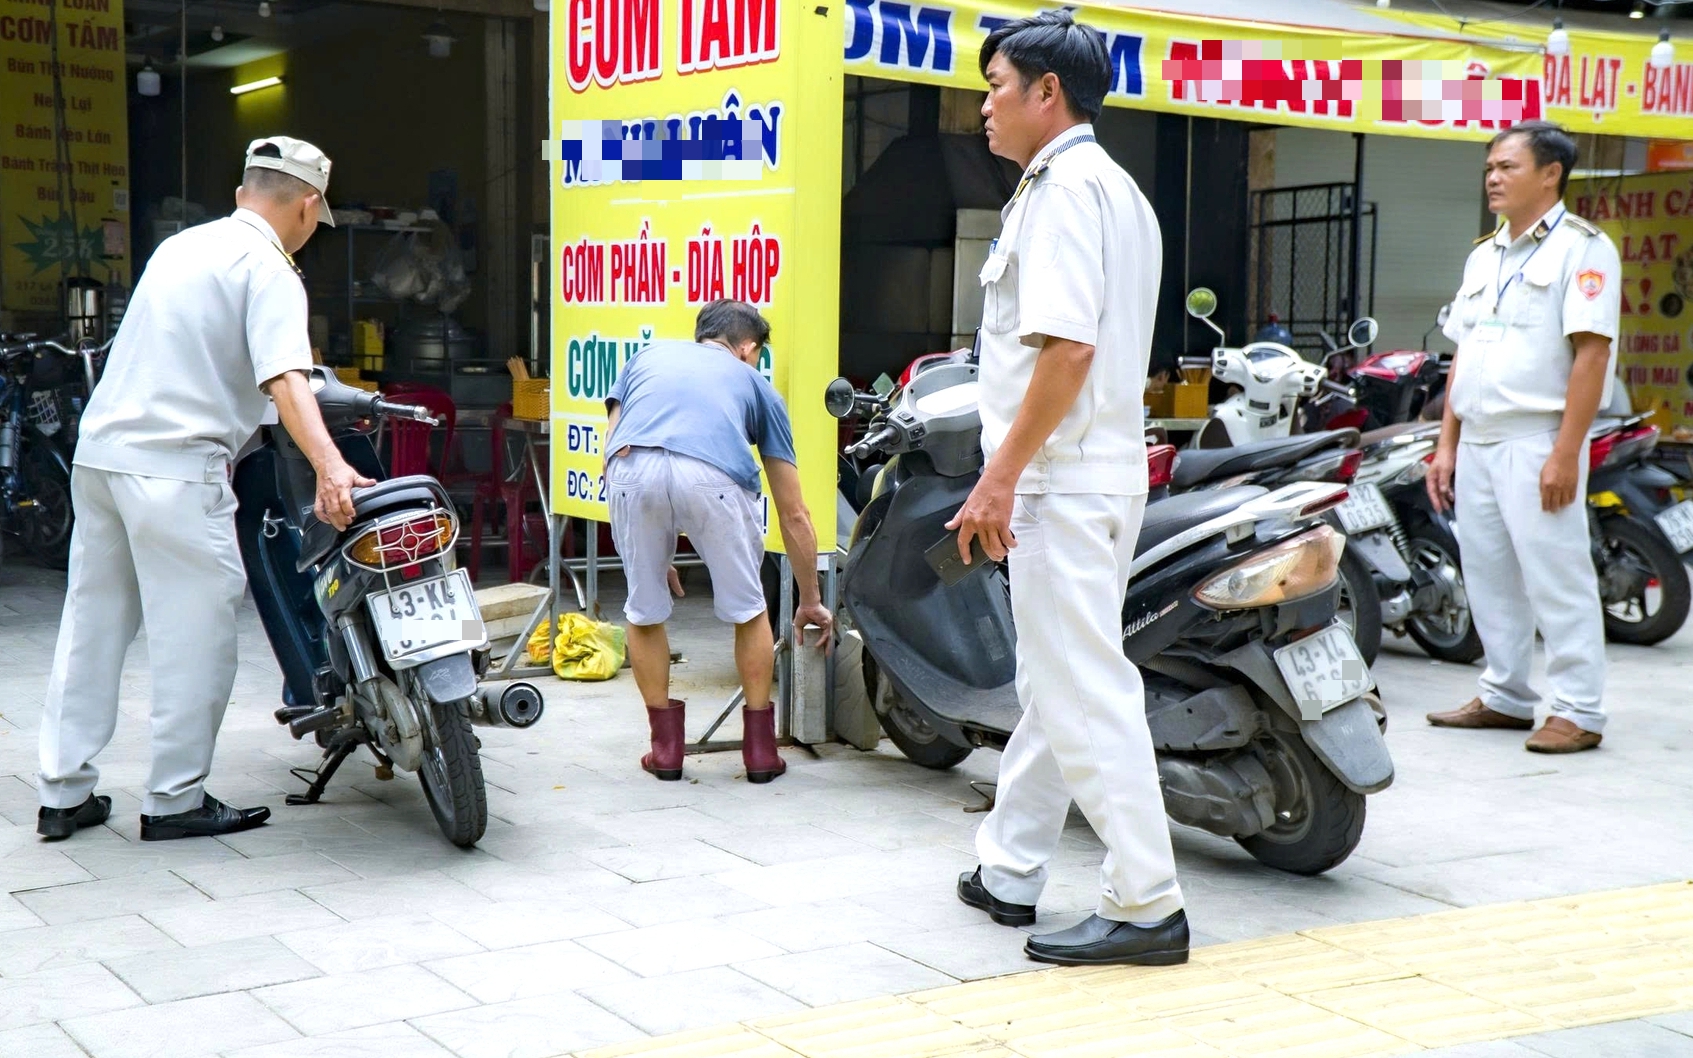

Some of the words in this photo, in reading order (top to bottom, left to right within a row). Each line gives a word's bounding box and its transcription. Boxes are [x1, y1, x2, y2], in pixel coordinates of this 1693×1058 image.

[1579, 56, 1621, 120] LẠT
[562, 239, 604, 303] CƠM
[610, 220, 666, 303] PHẦN
[688, 227, 725, 303] DĨA
[1622, 233, 1678, 268] LẠT
[567, 334, 618, 399] CƠM
[567, 424, 598, 454] ĐT:
[567, 470, 593, 501] ĐC:
[1122, 611, 1159, 641] Attila
